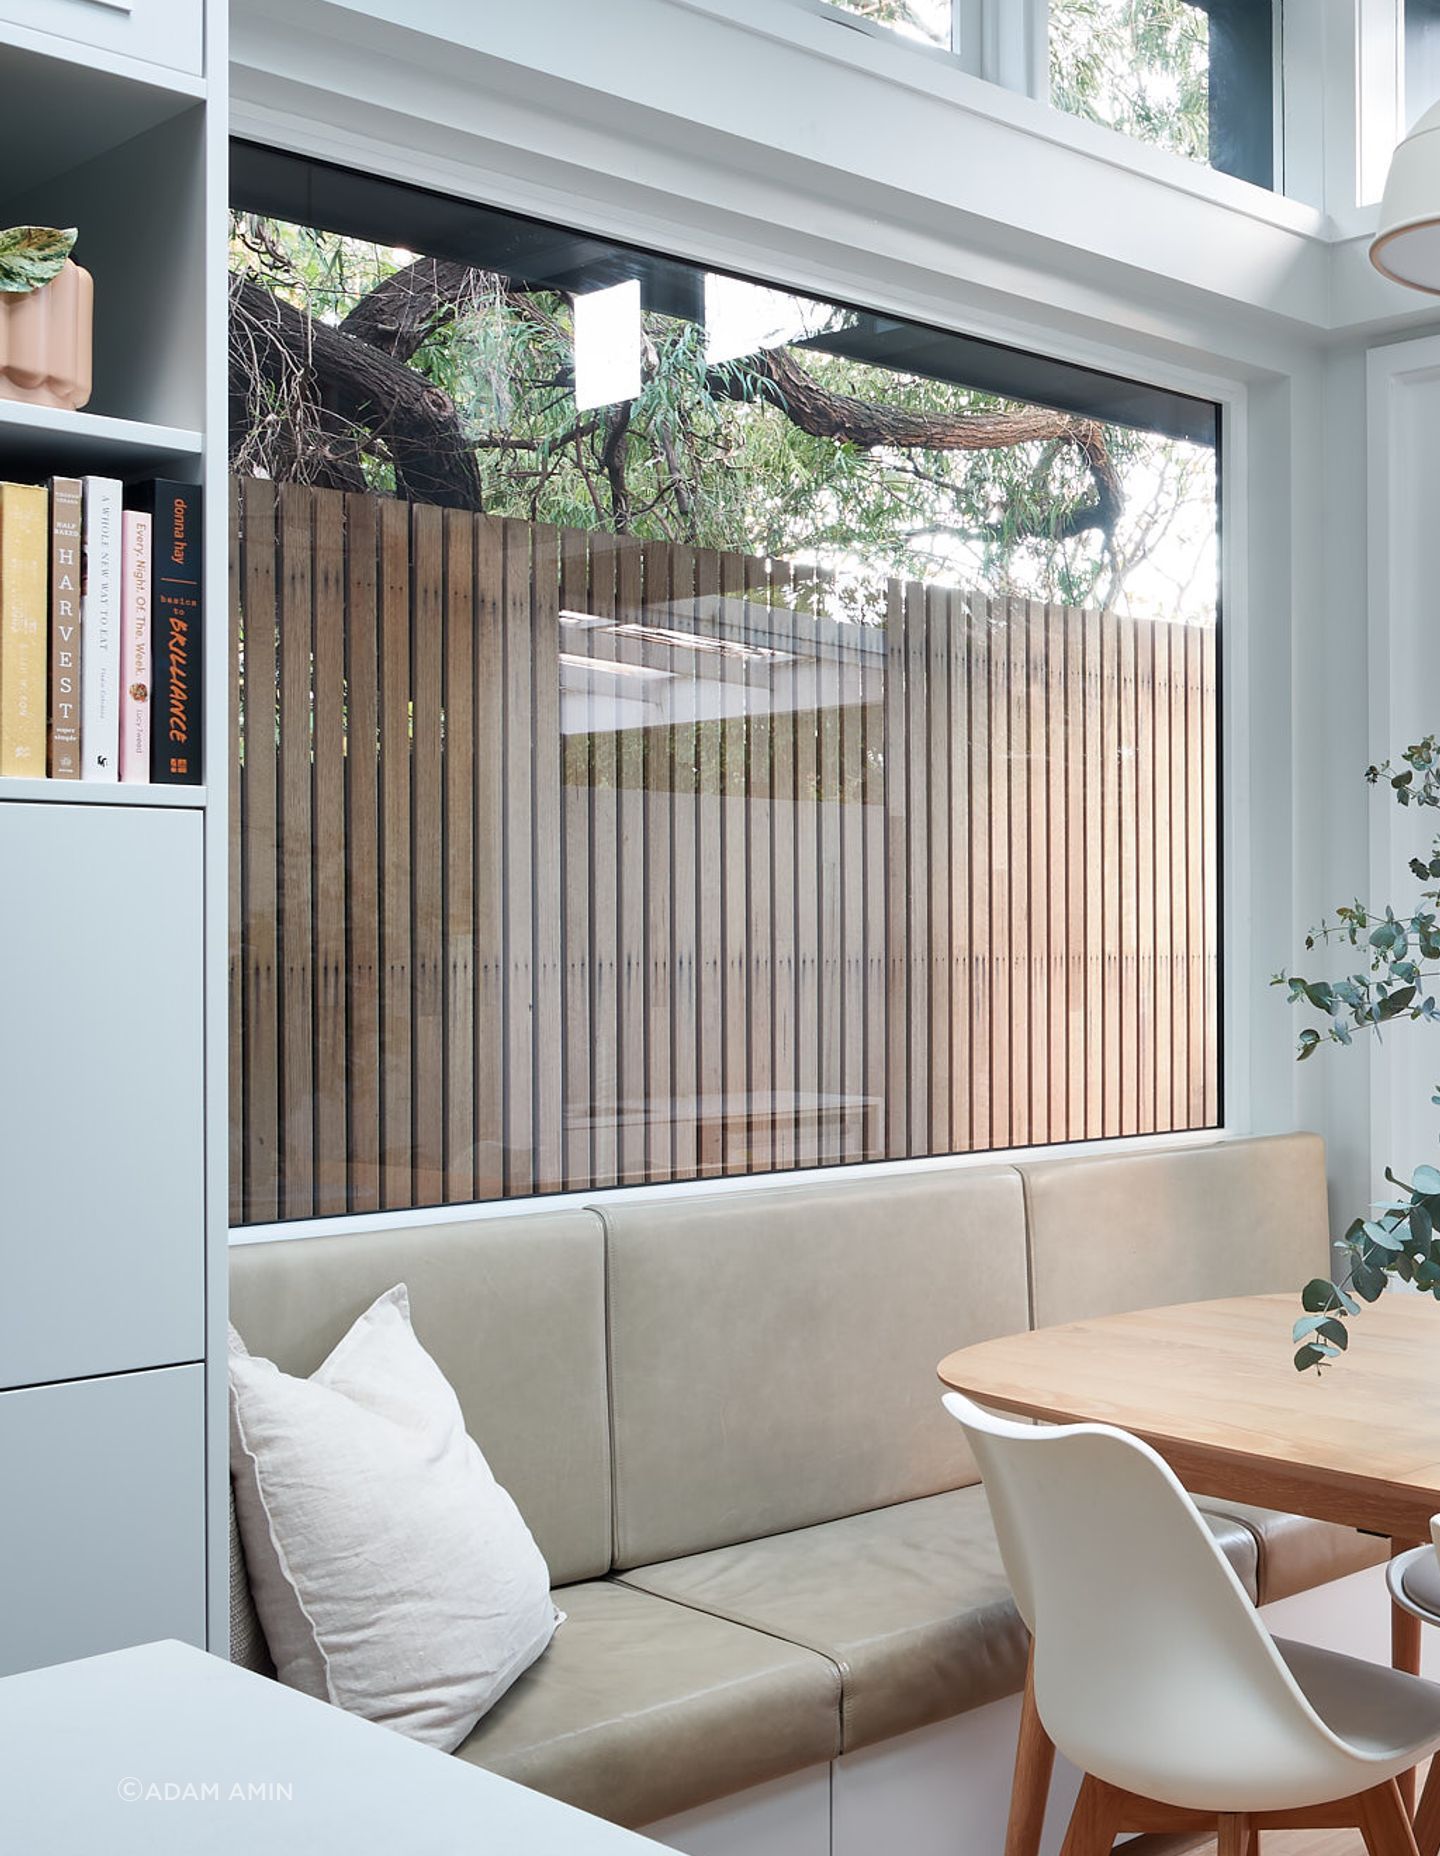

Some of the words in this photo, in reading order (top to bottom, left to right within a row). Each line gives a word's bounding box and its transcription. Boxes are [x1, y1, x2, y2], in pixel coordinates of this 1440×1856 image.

[101, 507, 110, 546] WHOLE
[174, 498, 187, 538] donna
[101, 552, 109, 578] NEW
[171, 541, 187, 565] hay
[100, 583, 109, 605] WAY
[100, 610, 109, 626] TO
[59, 548, 73, 718] HARVEST
[99, 628, 108, 651] EAT
[168, 617, 188, 743] BRILLIANCE
